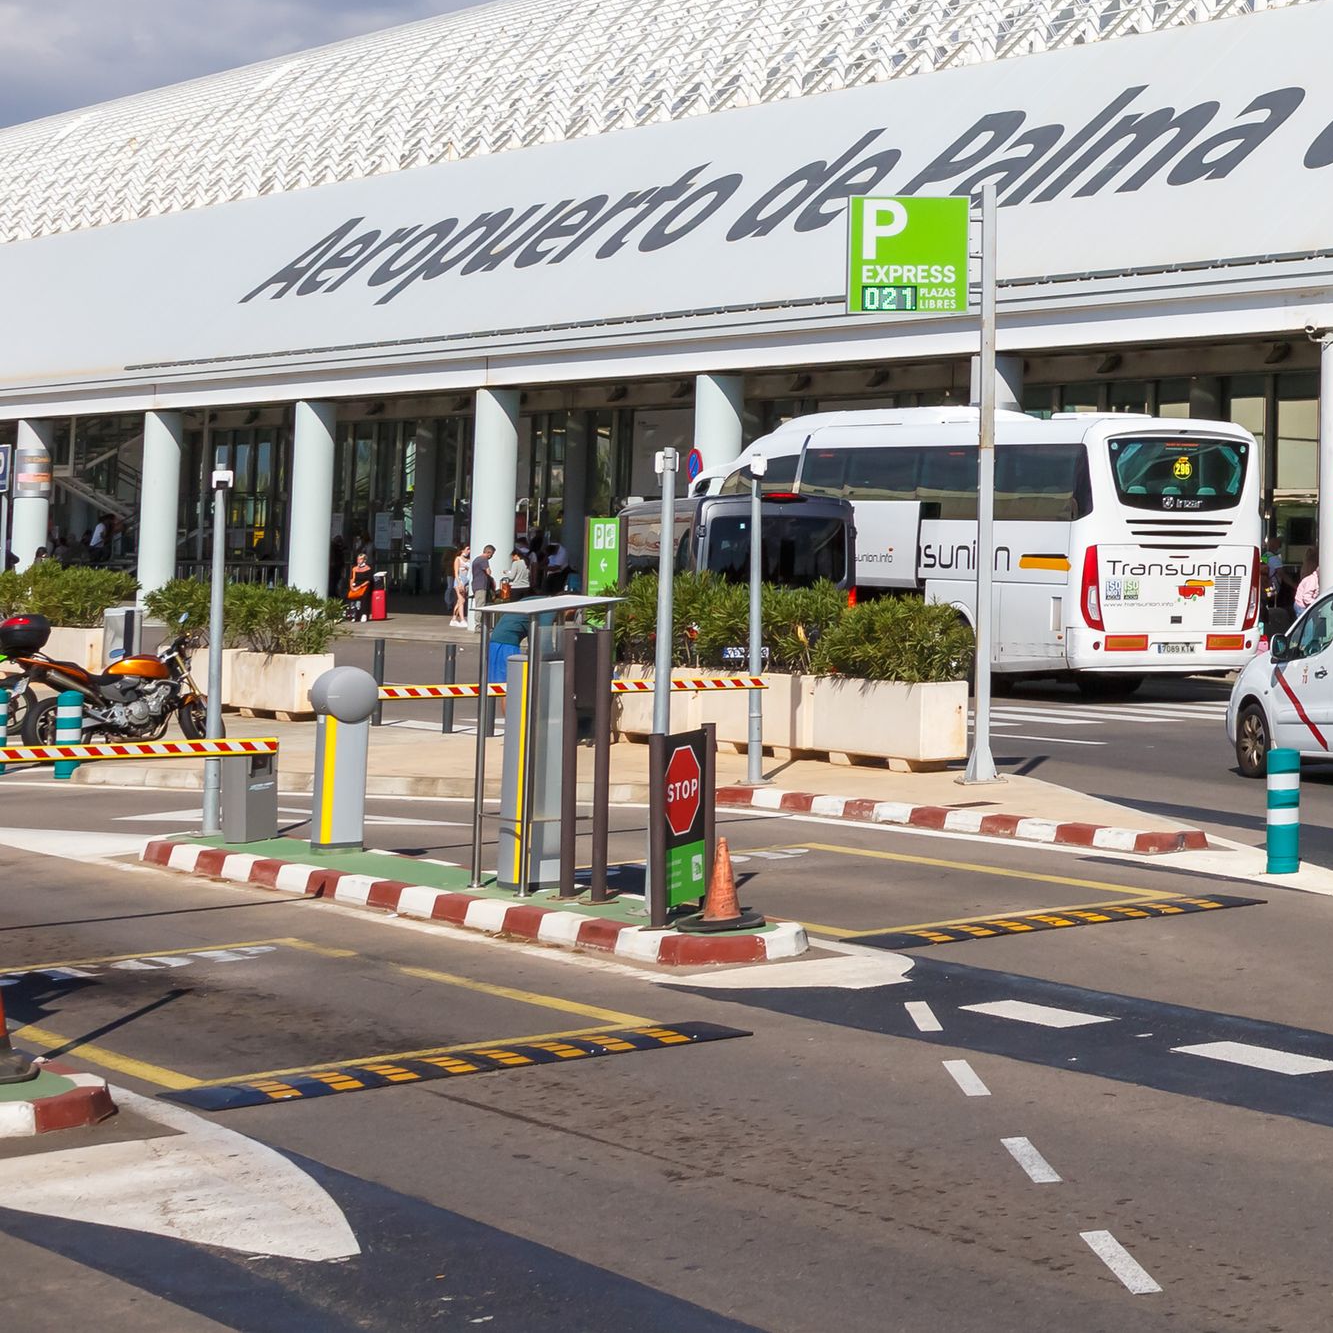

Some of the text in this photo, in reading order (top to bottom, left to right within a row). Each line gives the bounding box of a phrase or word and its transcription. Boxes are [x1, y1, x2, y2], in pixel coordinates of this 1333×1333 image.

[239, 162, 743, 306] Aeropuerto
[726, 128, 902, 243] de
[896, 84, 1306, 209] Palma
[862, 199, 908, 260] P
[862, 265, 956, 283] EXPRESS
[919, 288, 956, 297] PLAZAS
[919, 299, 957, 309] LIBRES
[1106, 560, 1247, 576] Transunion
[667, 778, 698, 803] STOP
